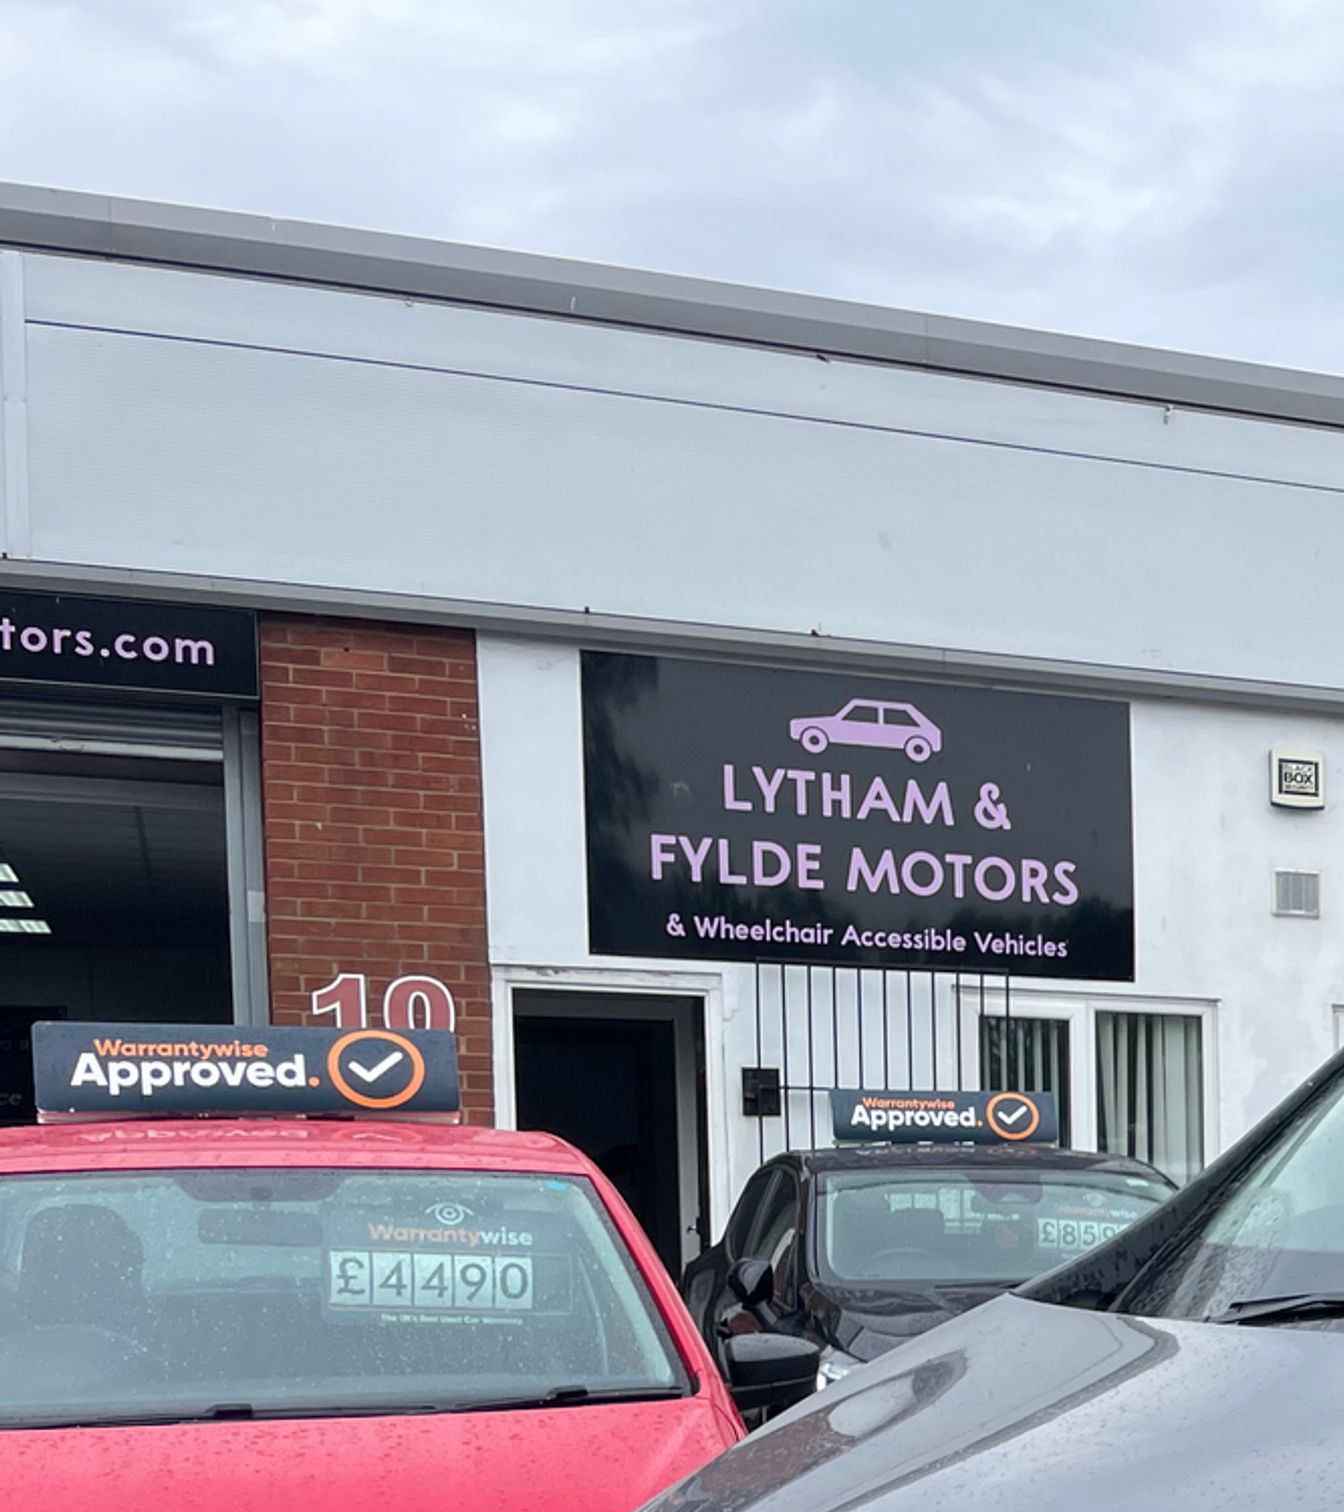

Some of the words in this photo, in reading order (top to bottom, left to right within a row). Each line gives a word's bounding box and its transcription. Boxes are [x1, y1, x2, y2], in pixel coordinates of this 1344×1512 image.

[0, 617, 215, 665] tors.com
[1284, 772, 1313, 784] BOX
[723, 764, 955, 826] LYTHAM
[974, 782, 1011, 830] &
[650, 833, 824, 890] FYLDE
[847, 847, 1079, 906] MOTORS
[666, 913, 685, 937] &
[694, 916, 833, 946] Wheelchair
[841, 925, 967, 953] Accessible
[974, 931, 1067, 957] Vehicles
[93, 1038, 269, 1060] Warrantywise
[70, 1052, 320, 1096] Approved.
[851, 1103, 983, 1131] Approved.
[862, 1097, 955, 1110] Warrantywise
[368, 1222, 533, 1247] Warrantywise
[1042, 1222, 1117, 1246] £859
[336, 1256, 529, 1301] £4490
